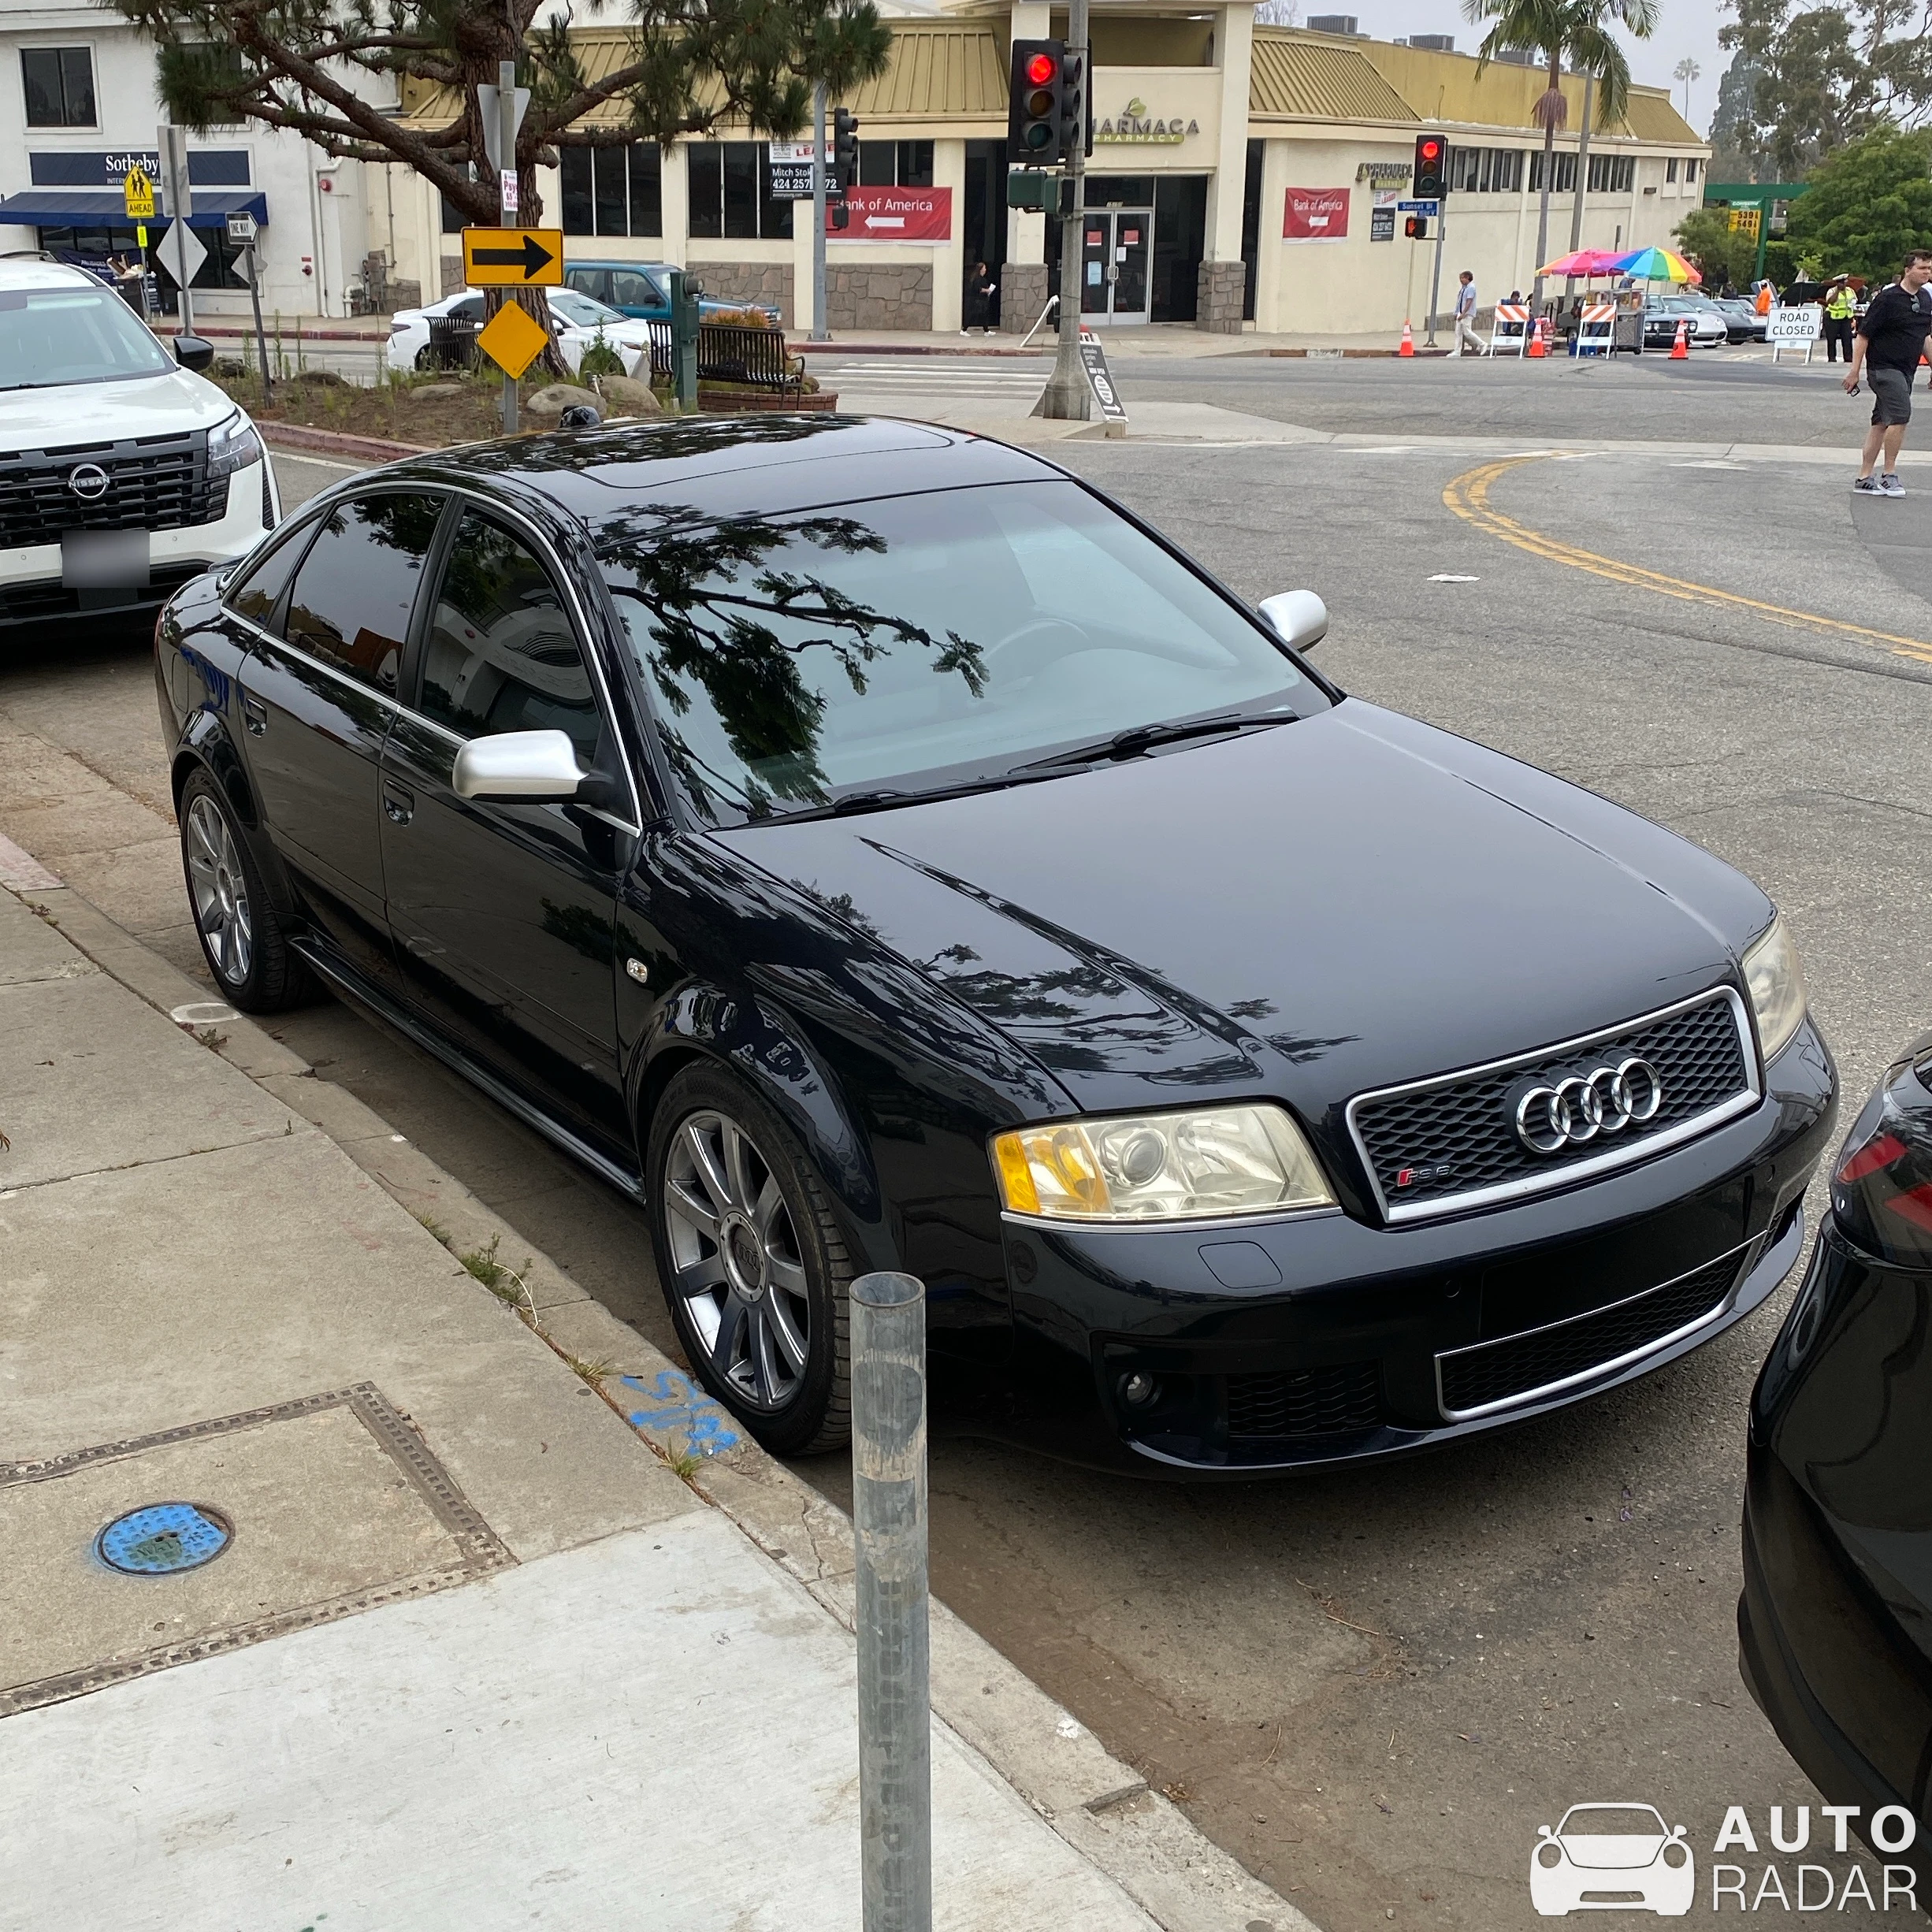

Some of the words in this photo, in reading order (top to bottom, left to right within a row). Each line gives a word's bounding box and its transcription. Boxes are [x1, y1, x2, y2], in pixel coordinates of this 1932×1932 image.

[772, 167, 793, 176] Mitch
[772, 178, 790, 189] 424
[793, 178, 810, 189] 257
[825, 178, 837, 189] 72
[128, 204, 152, 213] AHEAD
[841, 197, 865, 210] ank
[868, 198, 882, 210] of
[884, 198, 934, 210] America
[1294, 199, 1310, 210] Bank
[1310, 199, 1320, 210] of
[1318, 199, 1343, 210] America
[1780, 313, 1810, 322] ROAD
[1772, 325, 1815, 335] CLOSED
[68, 476, 110, 489] NISSAN
